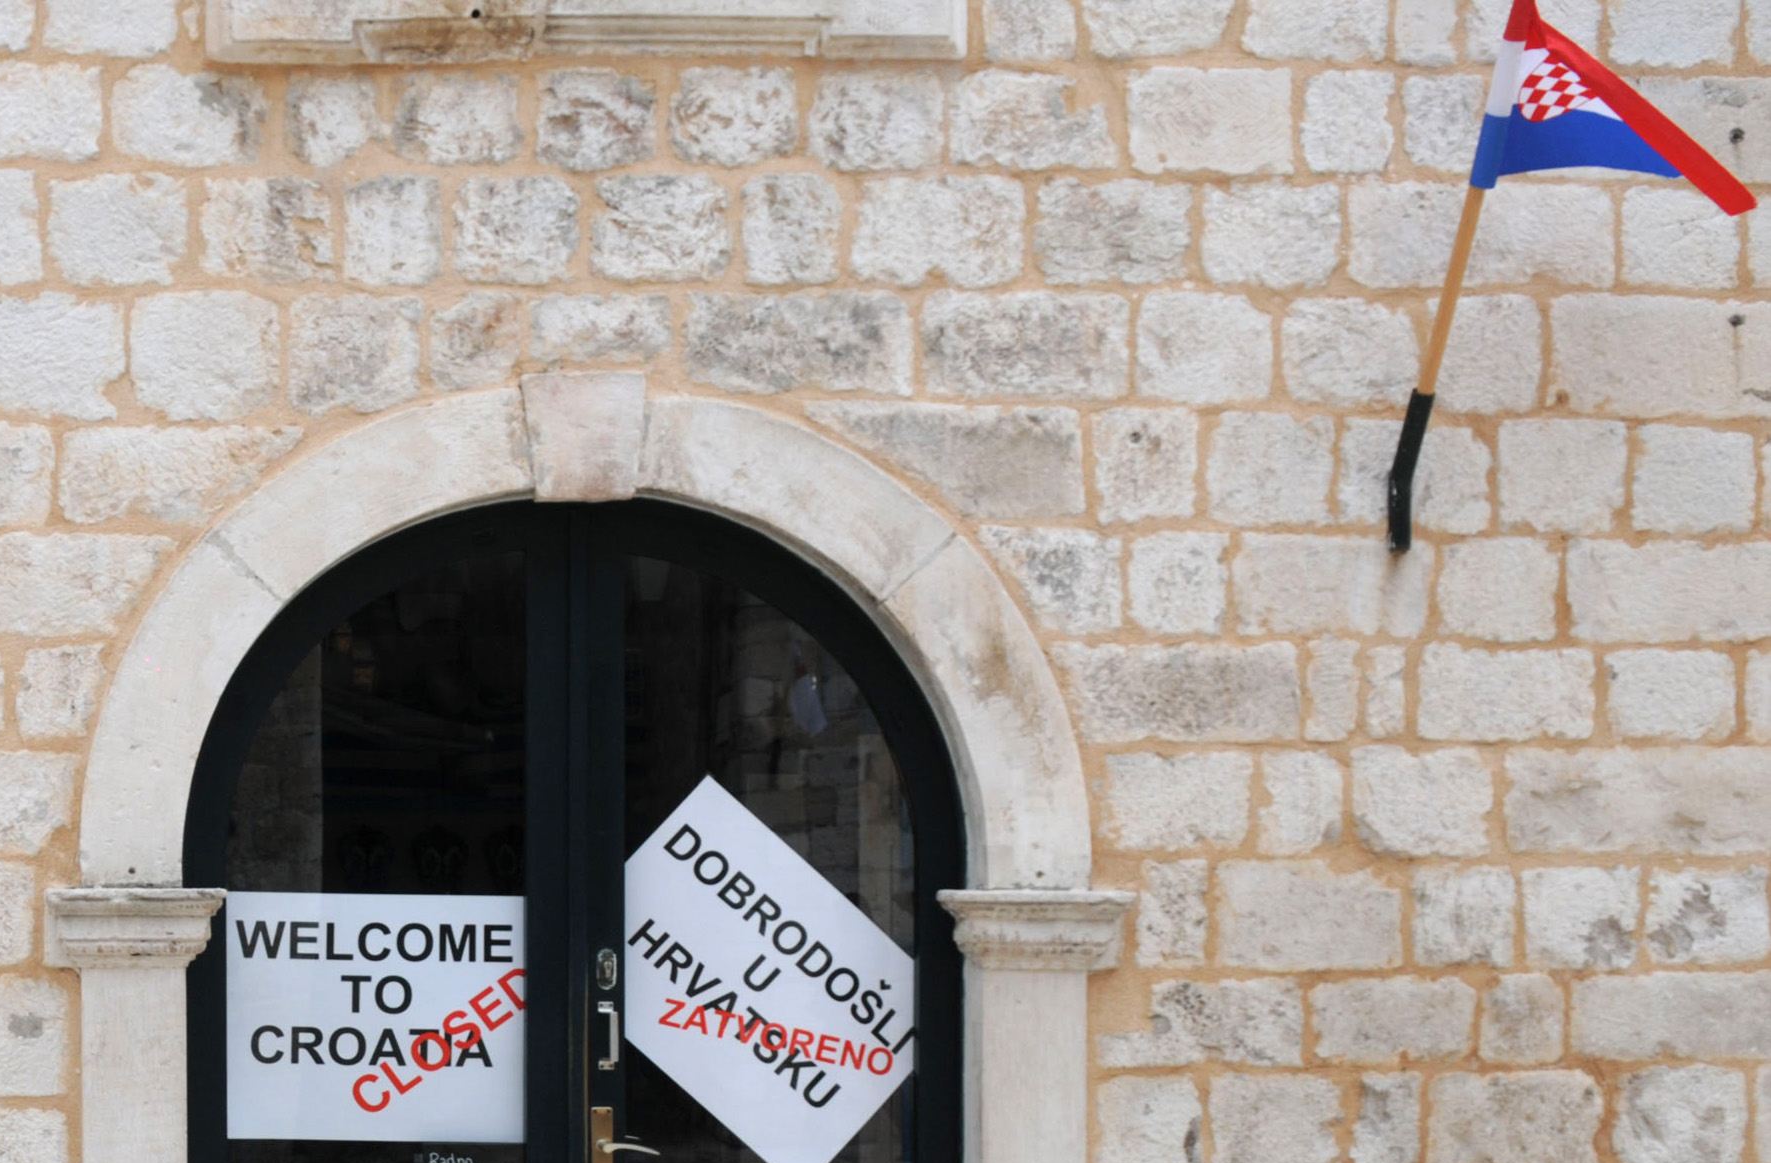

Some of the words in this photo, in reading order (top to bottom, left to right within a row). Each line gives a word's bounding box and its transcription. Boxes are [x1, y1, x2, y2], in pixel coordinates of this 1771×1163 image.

[235, 919, 514, 963] WELCOME
[663, 823, 915, 1055] DOBRODOŠLI
[340, 975, 413, 1015] TO
[742, 954, 782, 993] U
[352, 968, 527, 1113] CLOSED
[627, 918, 842, 1109] HRVATSKU
[658, 998, 894, 1076] ZATVORENO
[250, 1025, 493, 1068] CROATIA
